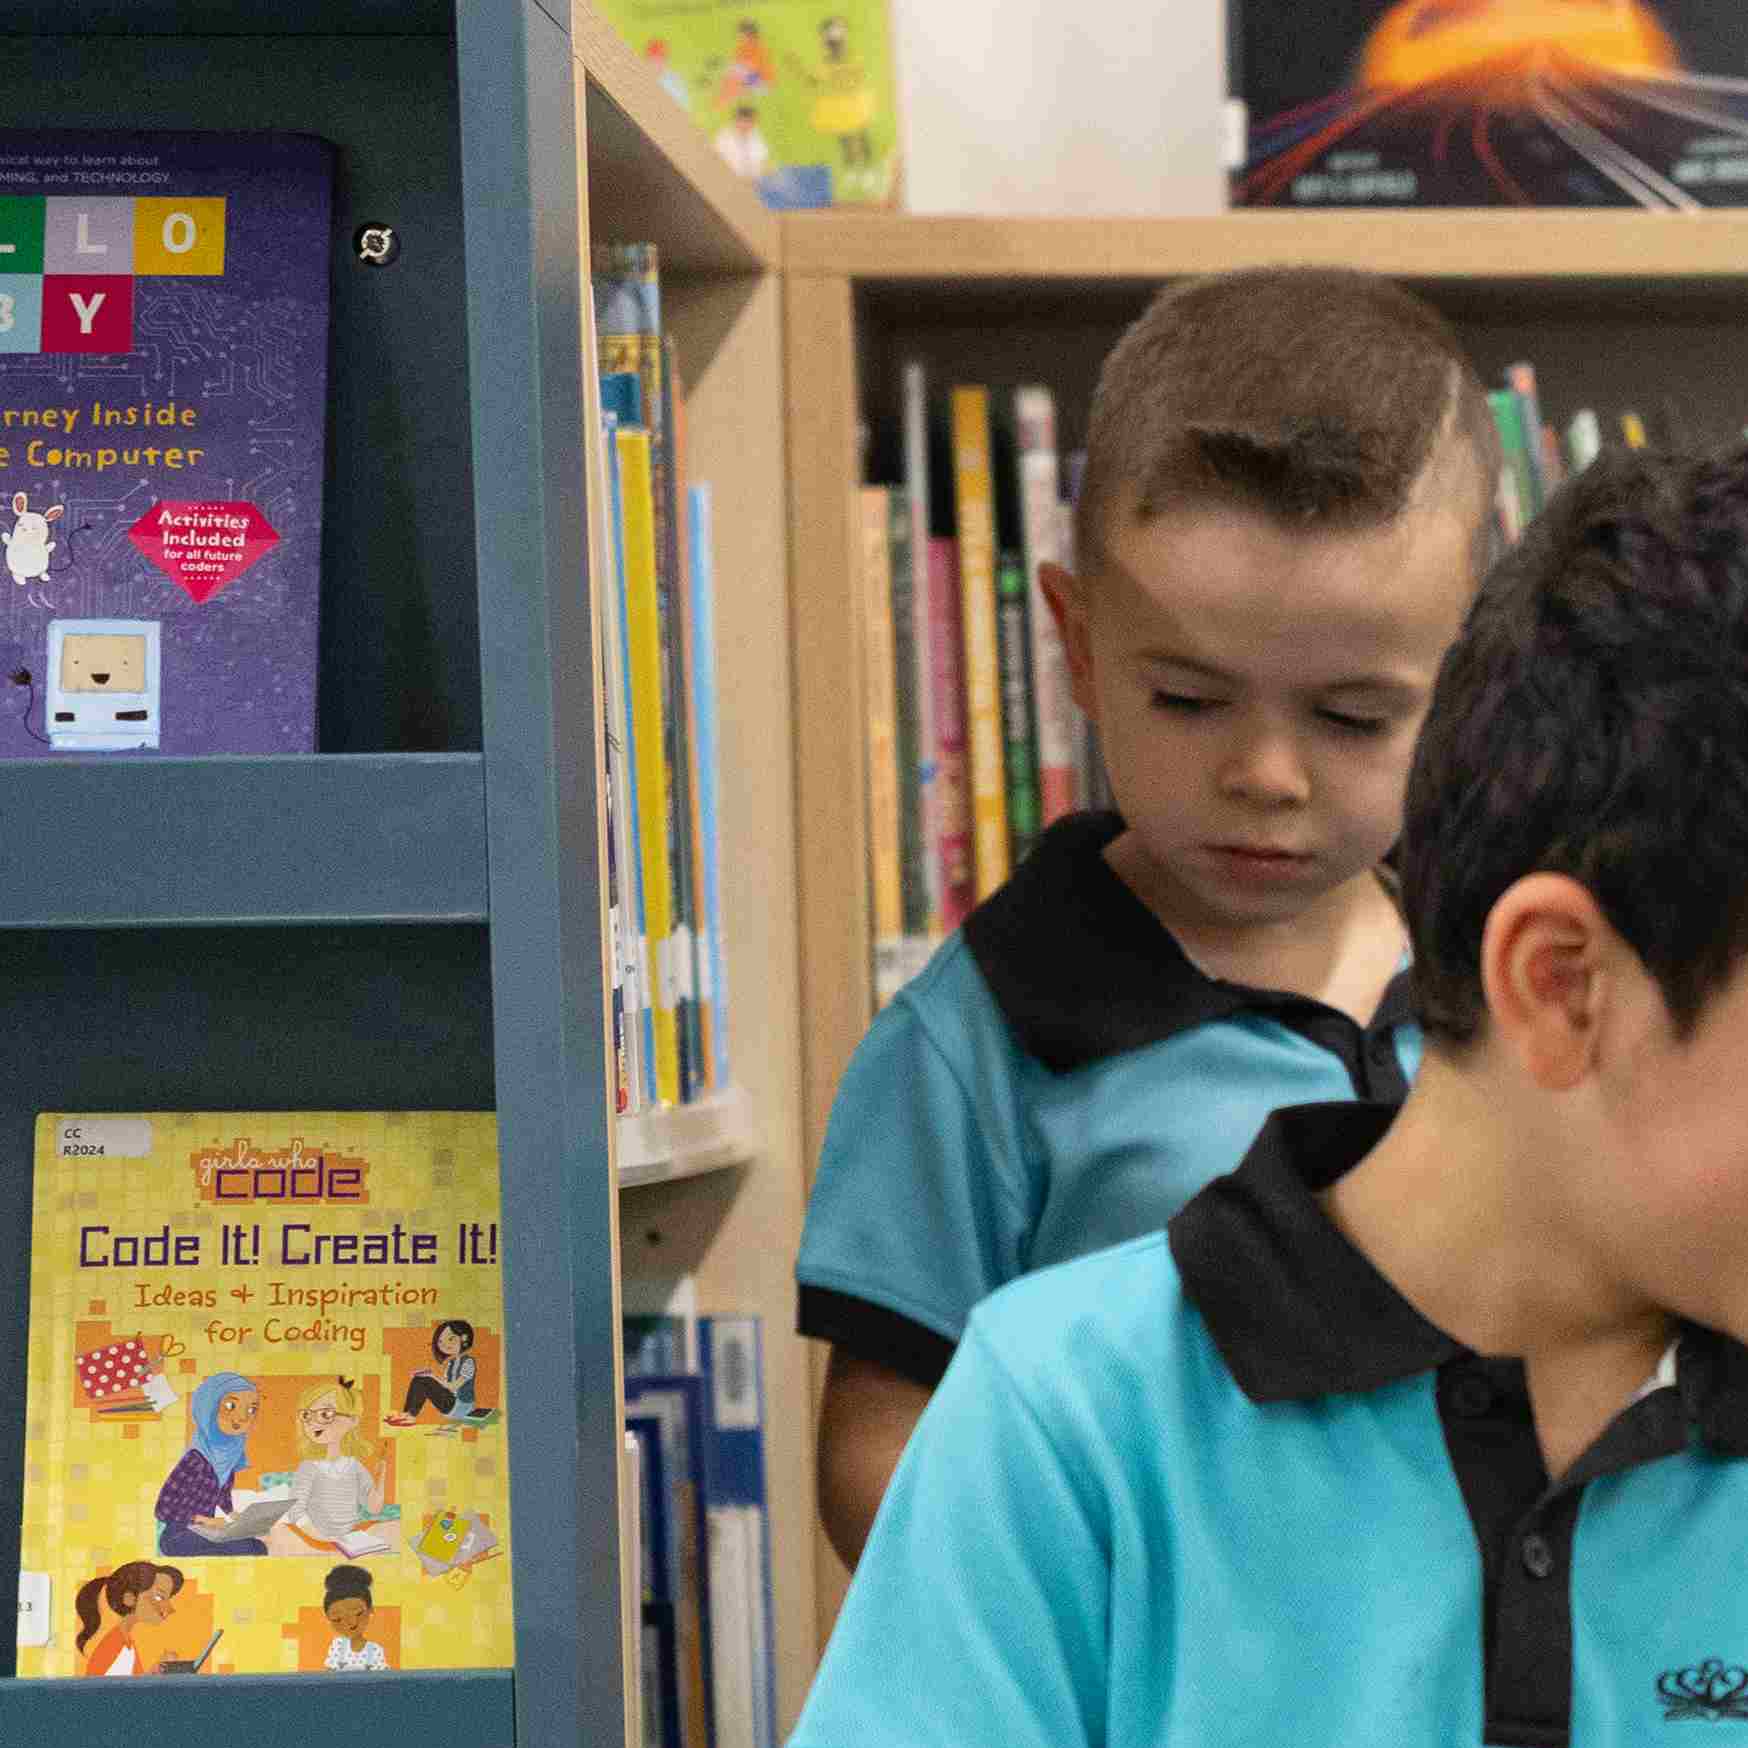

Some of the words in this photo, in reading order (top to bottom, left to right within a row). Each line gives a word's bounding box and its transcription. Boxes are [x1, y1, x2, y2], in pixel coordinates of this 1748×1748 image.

[83, 153, 116, 165] learn
[120, 154, 159, 165] about
[72, 171, 169, 184] TECHNOLOGY
[92, 402, 197, 427] Inside
[27, 440, 206, 470] Computer
[157, 510, 250, 530] Activities
[163, 531, 246, 548] Included
[164, 550, 183, 560] for
[186, 549, 201, 561] all
[204, 550, 243, 562] future
[180, 562, 225, 573] coders
[64, 1127, 82, 1140] CC
[215, 1155, 362, 1199] code
[79, 1224, 200, 1268] Code
[221, 1224, 260, 1266] It!
[281, 1223, 438, 1265] Create
[459, 1223, 497, 1265] It!
[134, 1283, 218, 1308] Ideas
[267, 1281, 439, 1316] Inspiration
[203, 1320, 251, 1344] for
[263, 1318, 367, 1351] Coding
